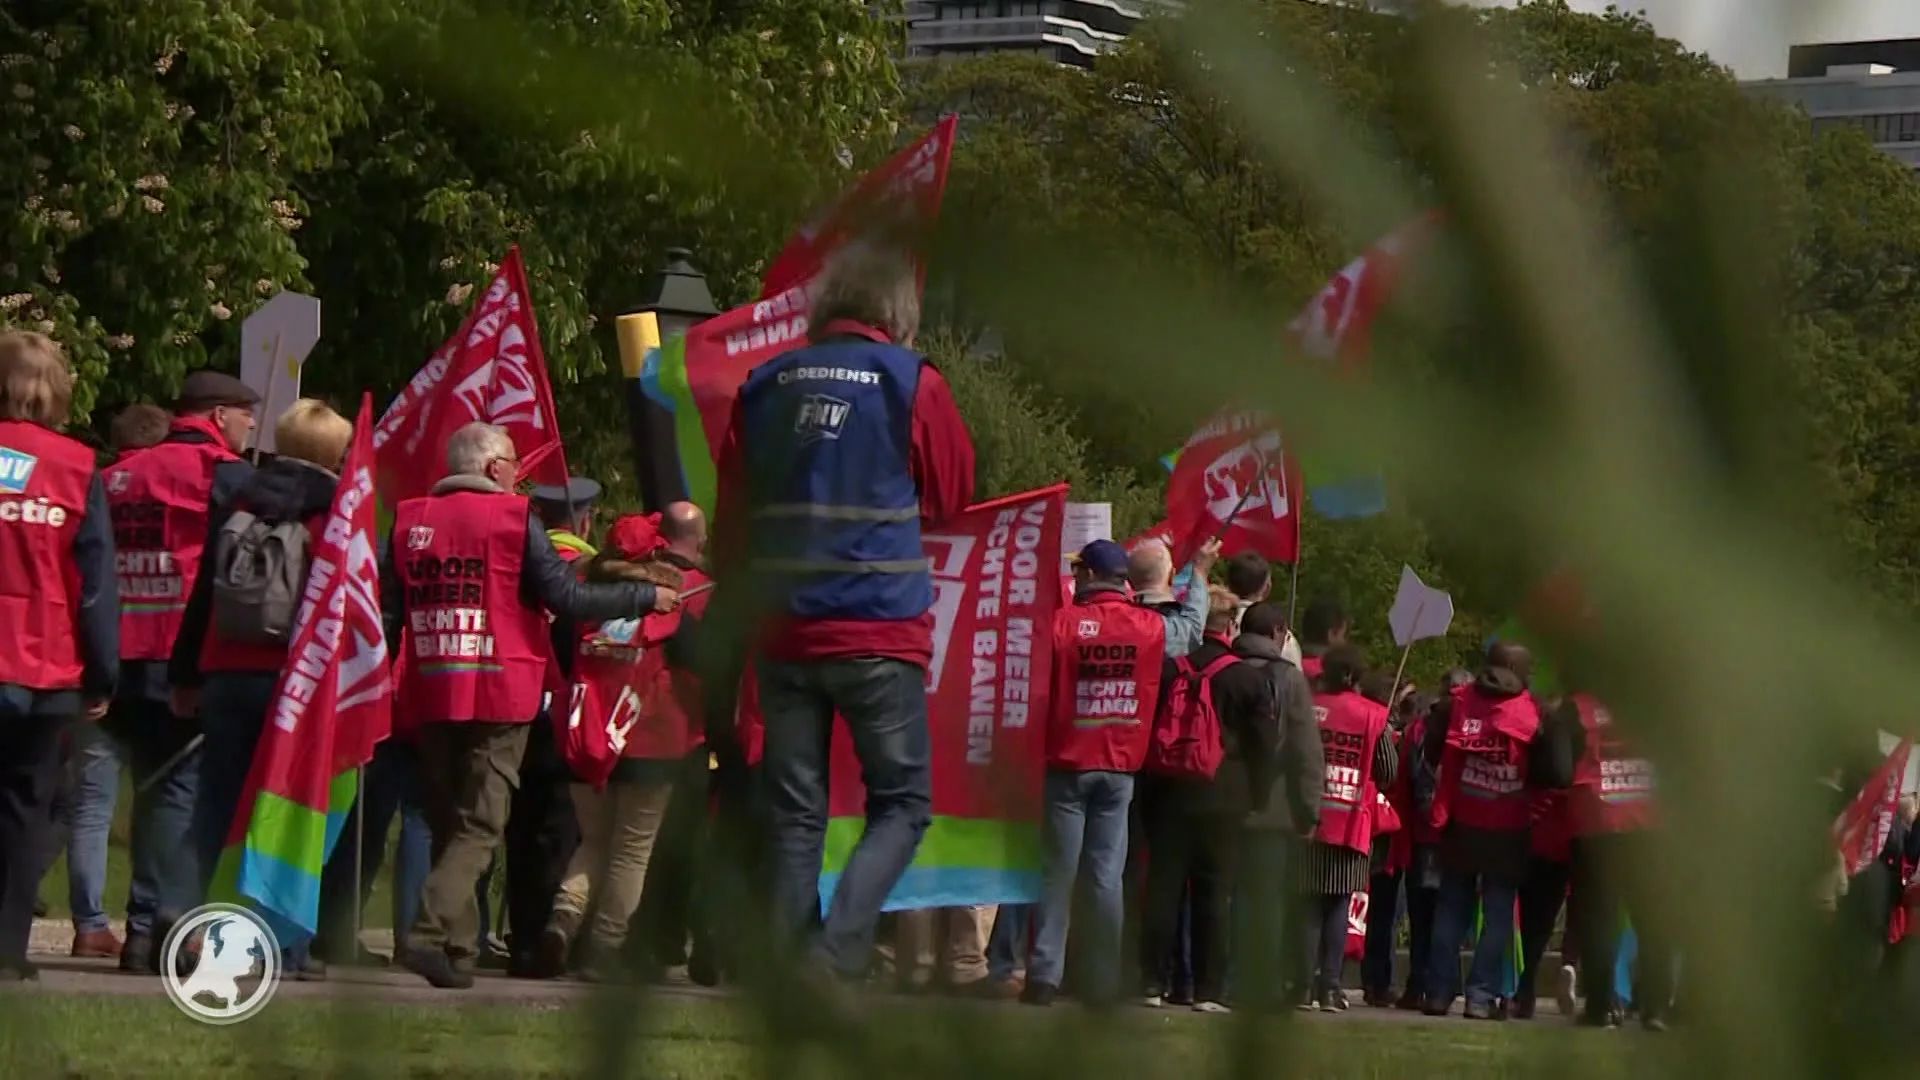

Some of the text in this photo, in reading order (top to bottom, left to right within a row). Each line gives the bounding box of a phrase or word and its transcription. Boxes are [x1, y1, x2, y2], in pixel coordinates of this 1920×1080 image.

[777, 366, 881, 385] ODEDIENST
[0, 456, 37, 481] NV
[0, 496, 66, 527] ctie
[115, 551, 174, 573] CHTE
[406, 556, 484, 580] VOOR
[117, 576, 184, 597] ANEN
[411, 608, 487, 632] ECHTE
[1002, 501, 1048, 729] VOOR MEER
[1077, 644, 1137, 661] VOOR
[966, 629, 998, 765] BANEN
[1077, 680, 1137, 697] ECHTE
[1320, 729, 1363, 749] OOR
[1325, 748, 1360, 767] EER
